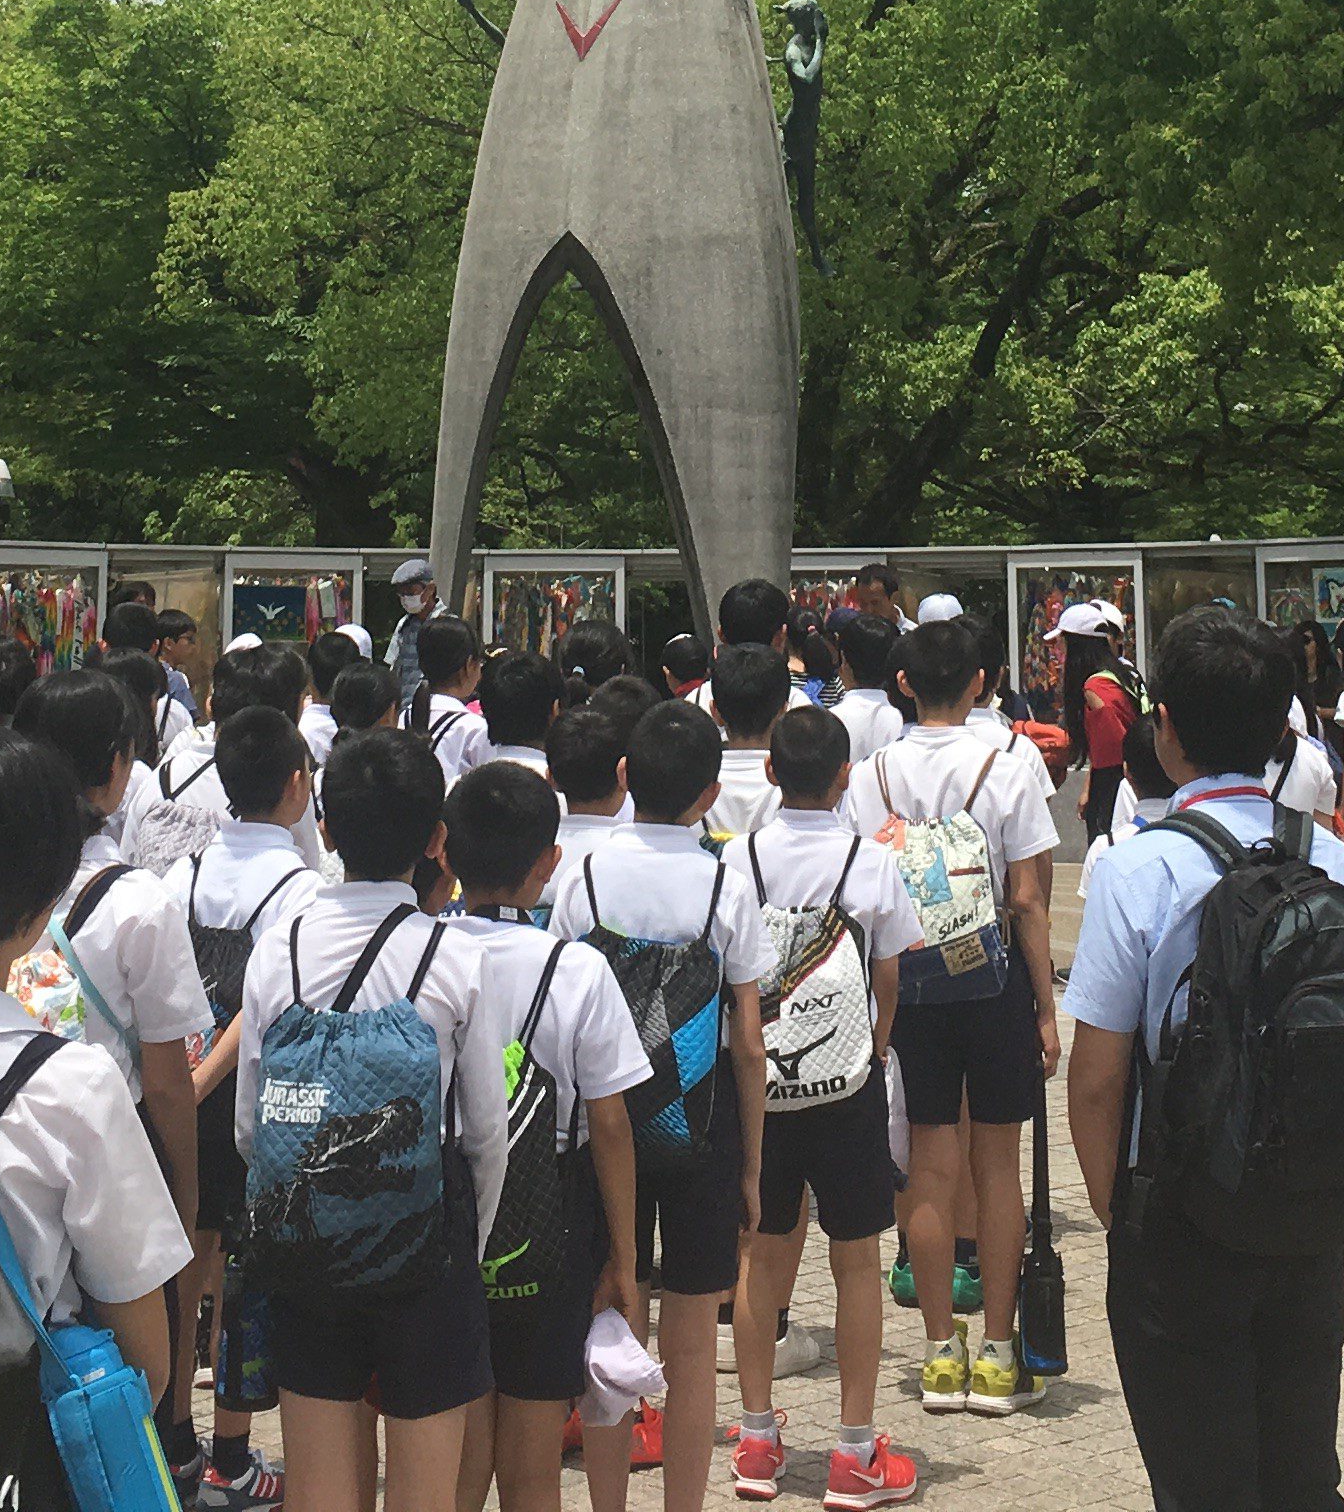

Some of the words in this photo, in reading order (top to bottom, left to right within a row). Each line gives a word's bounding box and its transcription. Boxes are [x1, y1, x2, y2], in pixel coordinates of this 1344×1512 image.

[259, 1077, 331, 1107] JURASSIC
[261, 1103, 322, 1124] PERIOD
[486, 1282, 539, 1299] ZUNO
